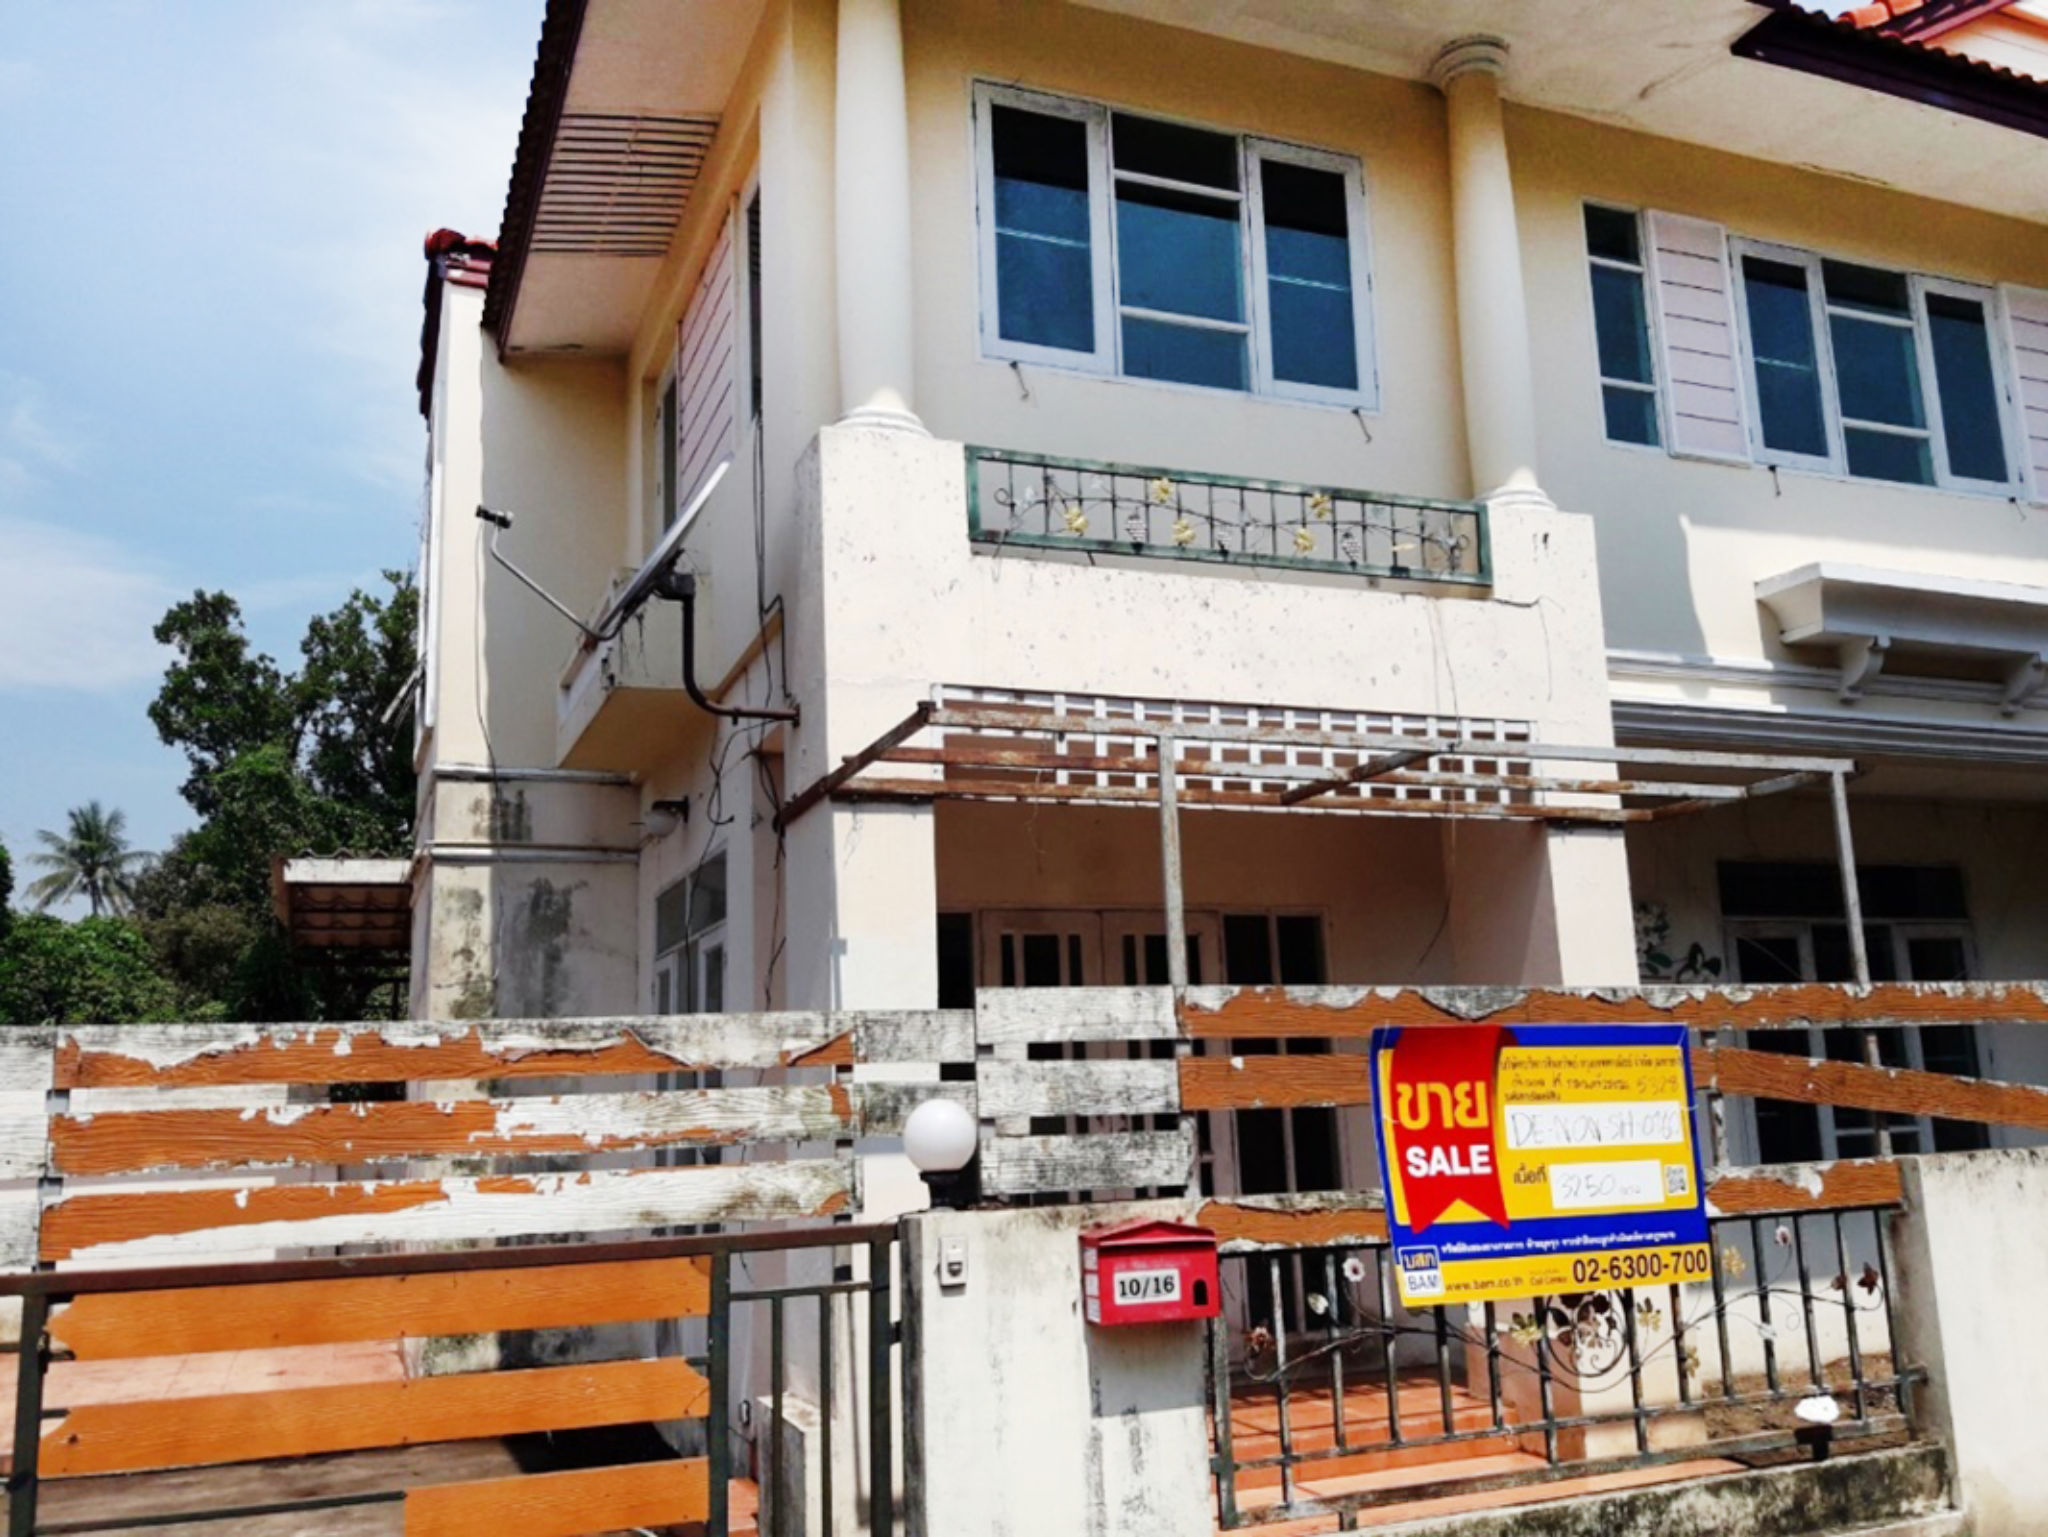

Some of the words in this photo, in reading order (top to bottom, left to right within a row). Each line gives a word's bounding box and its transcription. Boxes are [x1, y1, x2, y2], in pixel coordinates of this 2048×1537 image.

[1396, 1081, 1490, 1130] ขาย
[1406, 1144, 1492, 1177] SALE
[1407, 1273, 1438, 1291] BAM
[1573, 1249, 1707, 1284] 02-6300-700
[1119, 1276, 1175, 1299] 10/16
